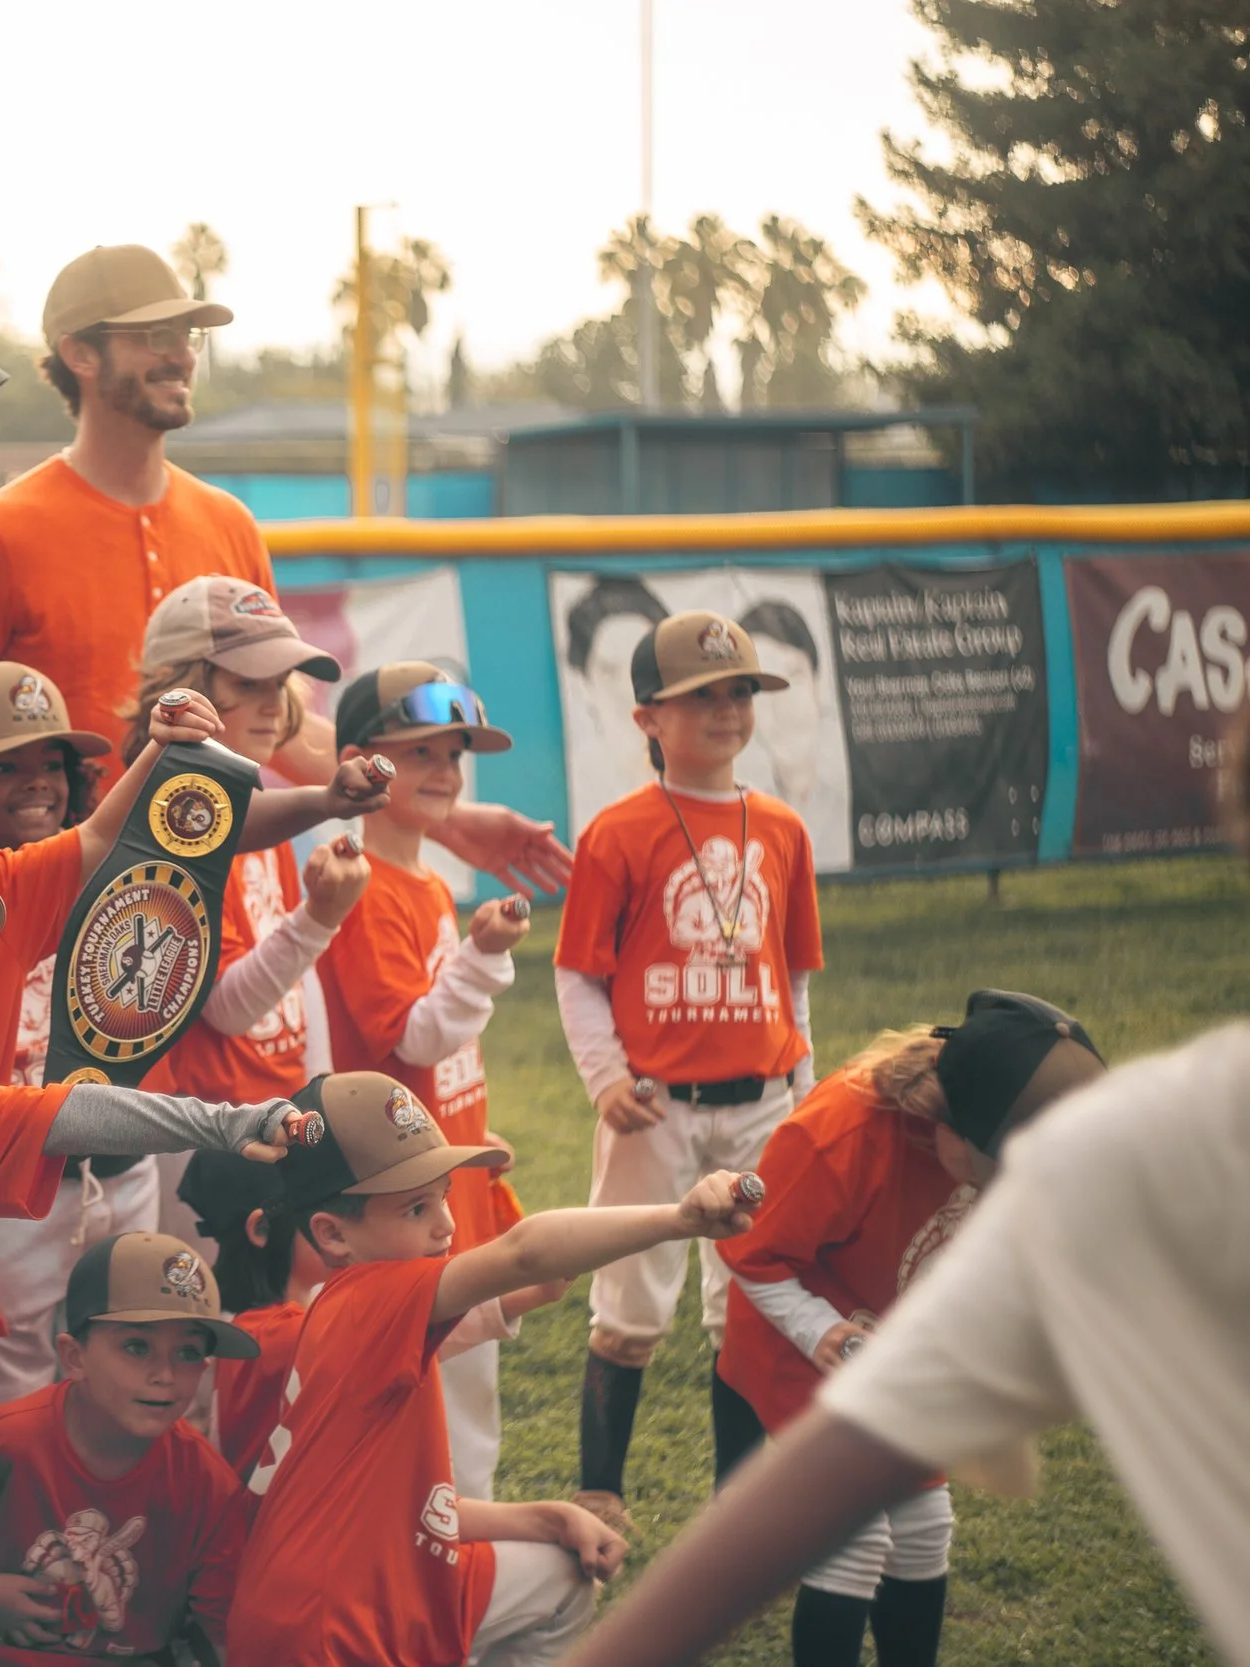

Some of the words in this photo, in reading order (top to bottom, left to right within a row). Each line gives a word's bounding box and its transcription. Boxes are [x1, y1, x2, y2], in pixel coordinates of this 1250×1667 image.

[1107, 585, 1250, 717] CAS
[858, 808, 970, 848] COMPASS
[81, 888, 150, 962] TOURNAMENT
[98, 938, 114, 987] SHERMAN
[110, 919, 132, 941] OAKS
[79, 965, 105, 1023] TURKEY
[148, 972, 167, 1007] LITTLE
[160, 937, 181, 974] LEAGUE
[162, 939, 199, 1020] CHAMPIONS
[644, 961, 779, 1010] SOLL
